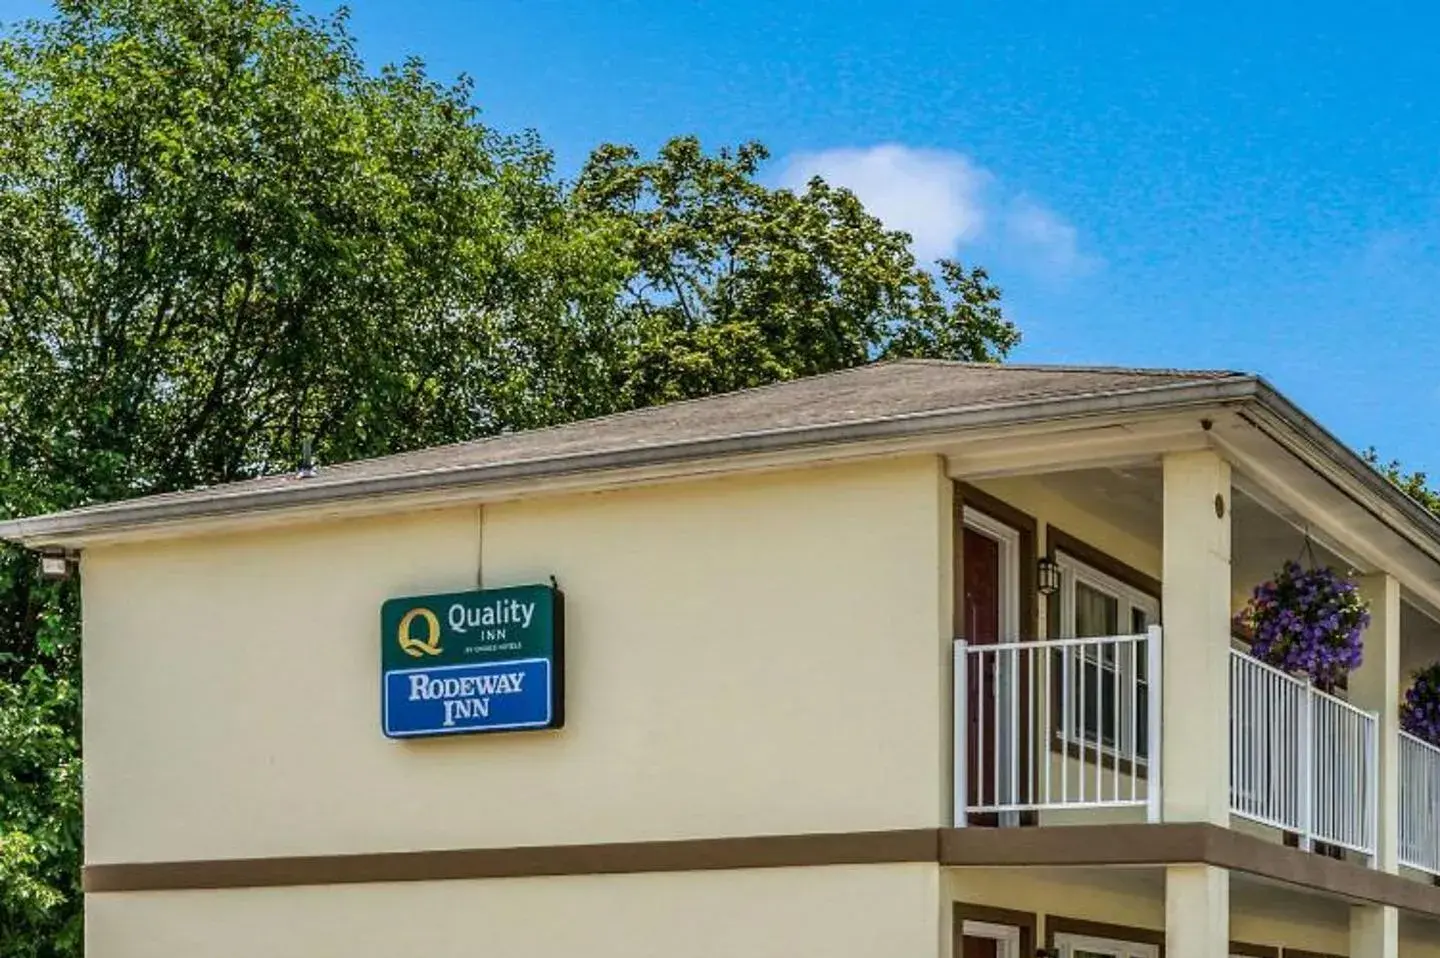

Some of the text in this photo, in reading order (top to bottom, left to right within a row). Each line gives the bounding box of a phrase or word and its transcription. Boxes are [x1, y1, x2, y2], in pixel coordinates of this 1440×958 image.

[448, 598, 535, 633] Quality
[481, 629, 506, 641] INN
[409, 672, 526, 701] RODEWAY
[443, 697, 490, 726] INN
